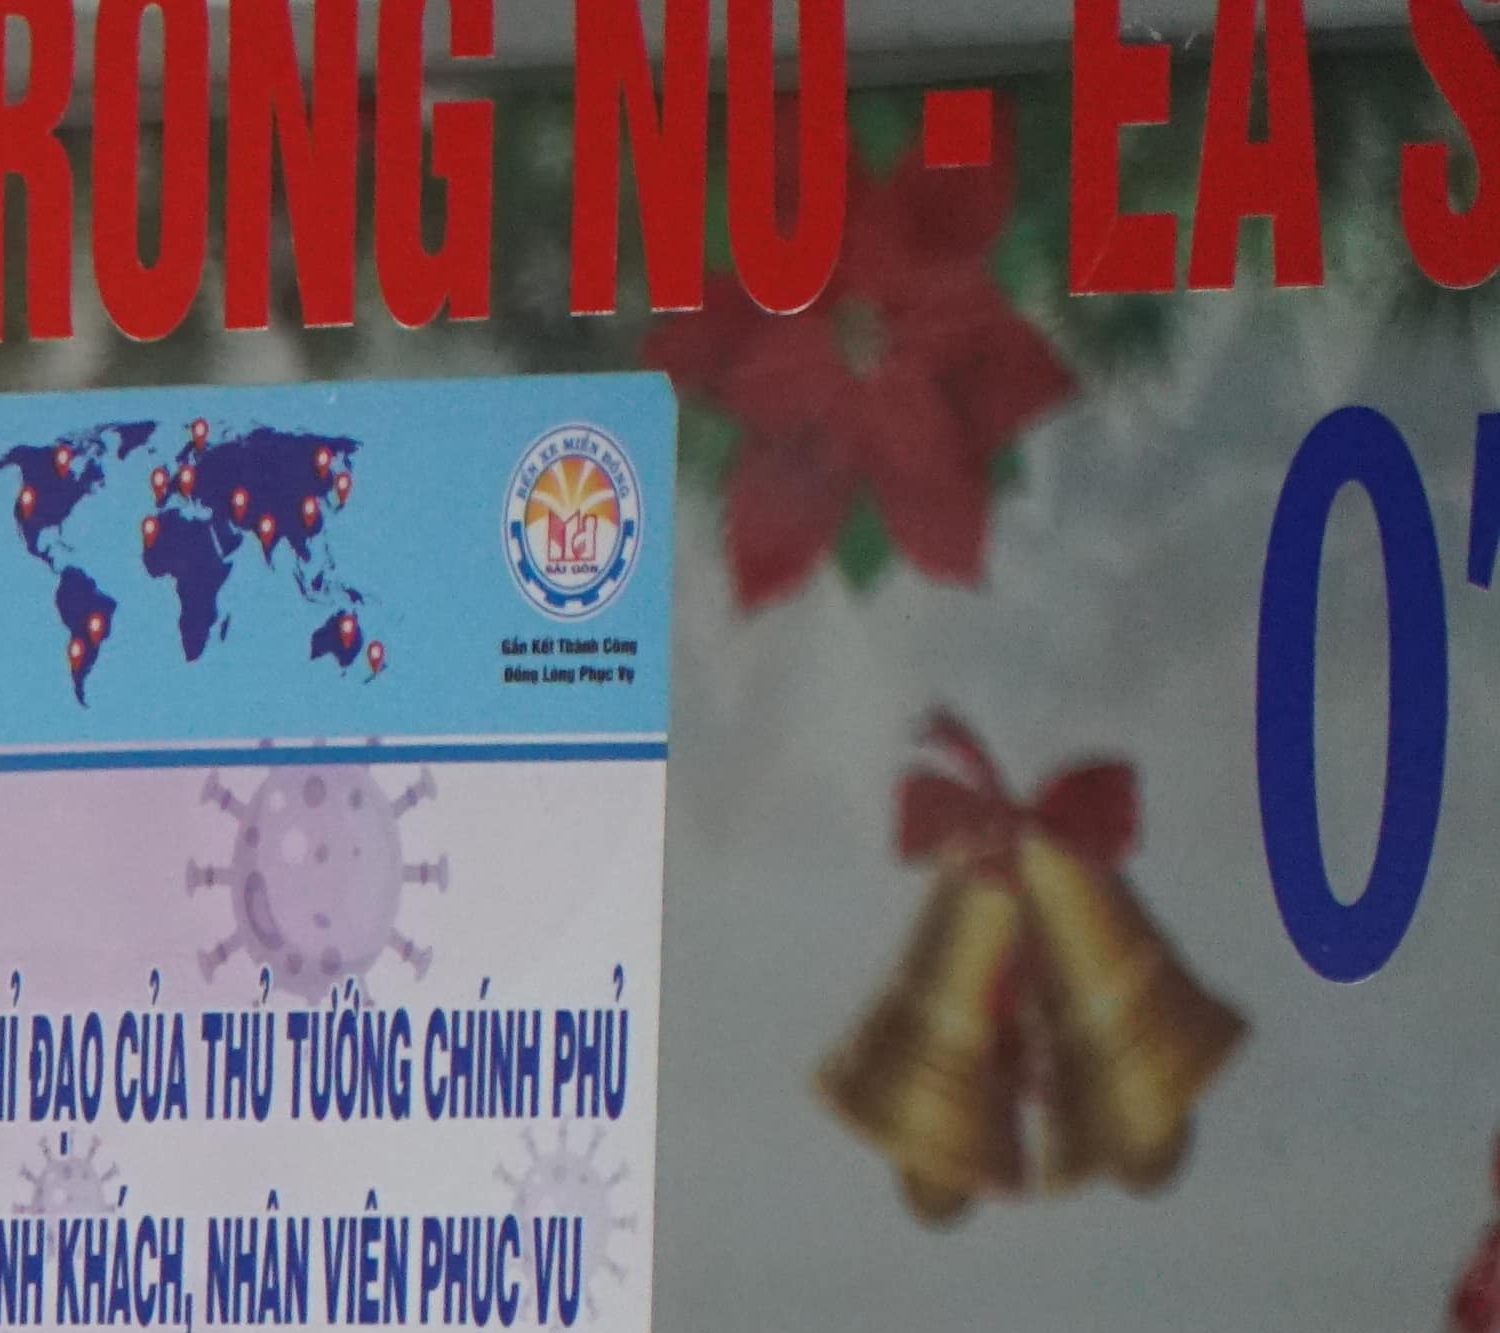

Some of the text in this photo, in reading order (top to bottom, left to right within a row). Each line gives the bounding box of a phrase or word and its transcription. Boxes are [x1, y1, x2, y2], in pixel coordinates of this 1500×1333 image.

[29, 1012, 102, 1154] ĐẠO
[115, 967, 189, 1121] CỦA
[201, 964, 275, 1121] THỦ
[286, 976, 412, 1121] TƯỚNG
[423, 976, 541, 1120] CHÍNH
[552, 962, 630, 1120] PHỦ
[206, 1189, 311, 1326] NHÂN
[322, 1189, 409, 1326] VIÊN
